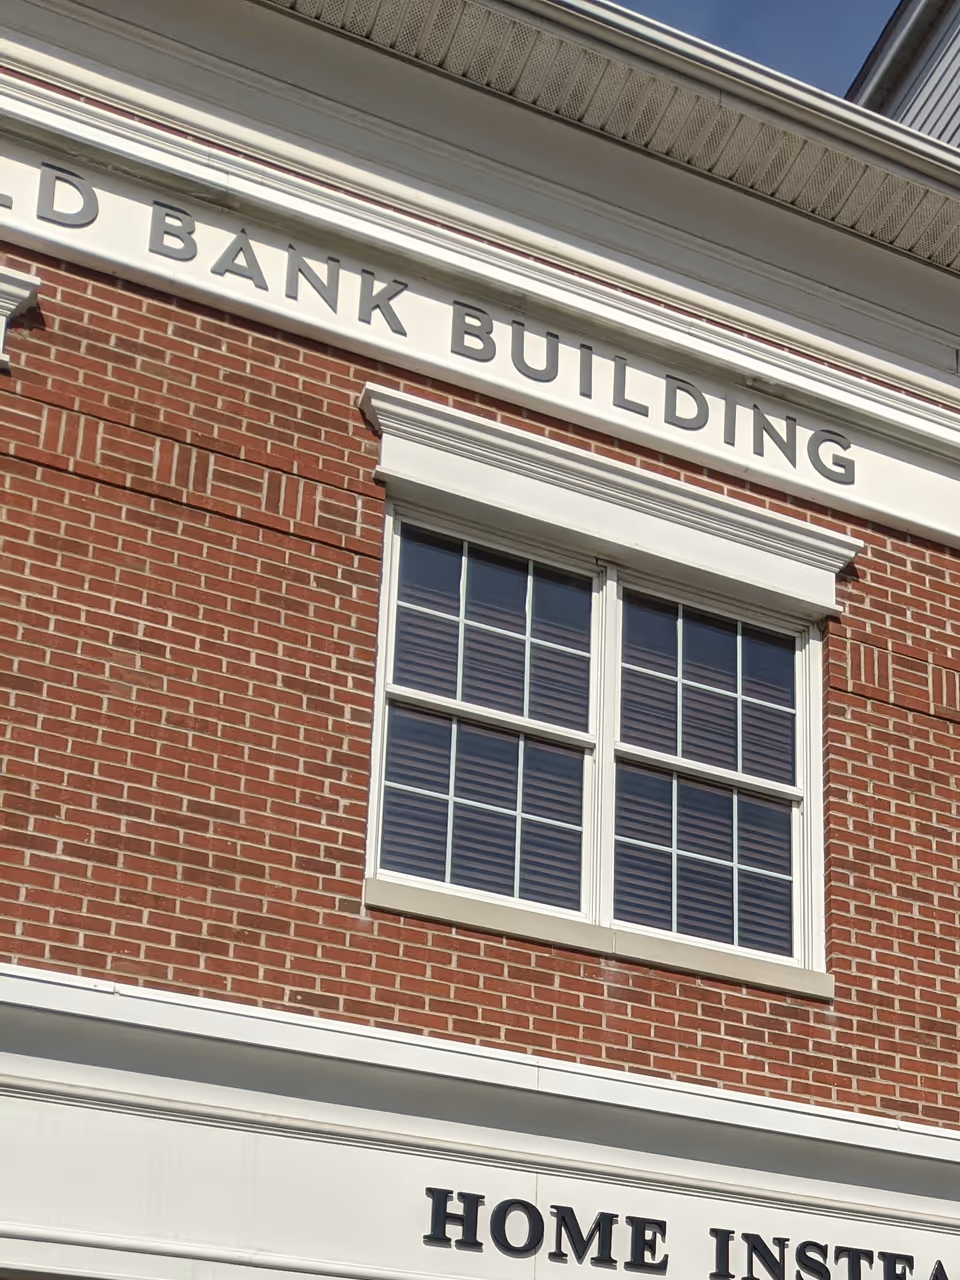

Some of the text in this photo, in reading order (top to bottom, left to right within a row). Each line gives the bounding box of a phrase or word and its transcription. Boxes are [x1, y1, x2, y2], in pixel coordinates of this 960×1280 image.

[148, 200, 408, 337] BANK
[451, 300, 855, 485] BUILDING
[422, 1187, 670, 1275] HOME
